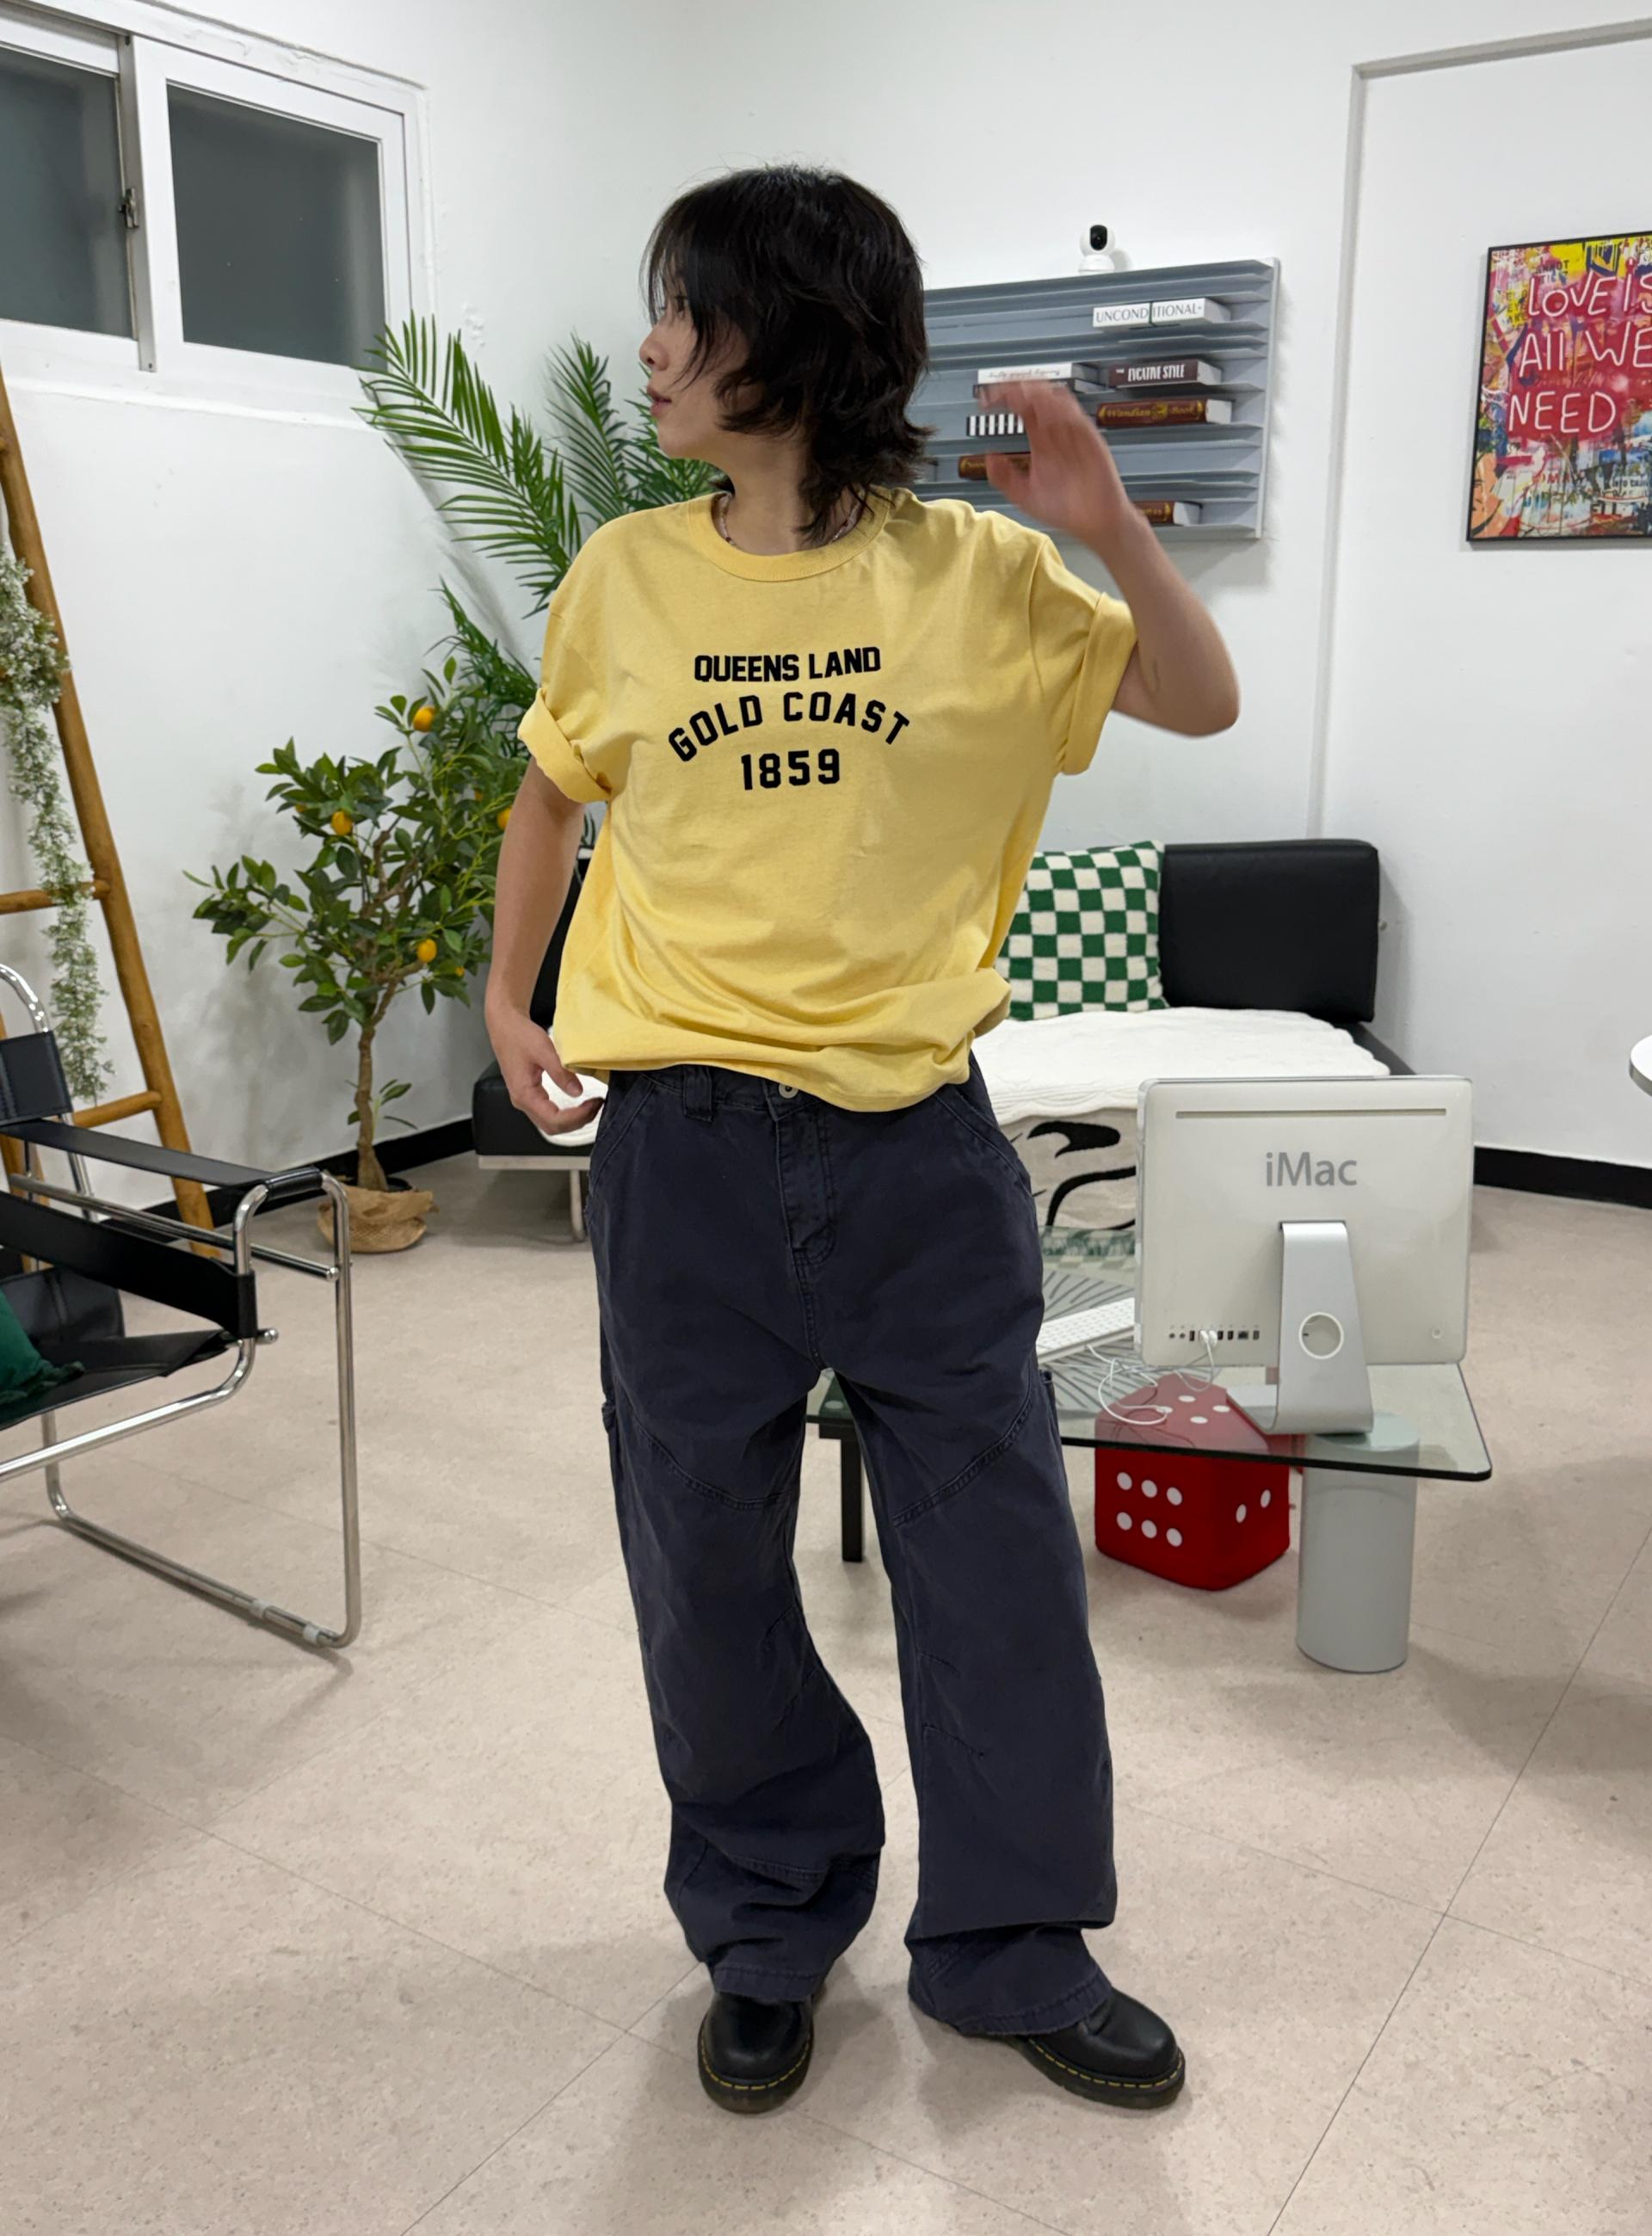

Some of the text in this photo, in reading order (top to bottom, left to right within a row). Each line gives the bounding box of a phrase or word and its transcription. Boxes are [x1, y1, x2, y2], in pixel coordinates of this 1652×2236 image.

[1528, 268, 1617, 317] LOVE
[1585, 320, 1652, 368] WE
[1508, 391, 1617, 433] NEED
[694, 647, 881, 682] QUEENS LAND
[668, 692, 910, 762] GOLD COAST
[741, 748, 840, 791] 1859
[1266, 1151, 1358, 1186] iMac
